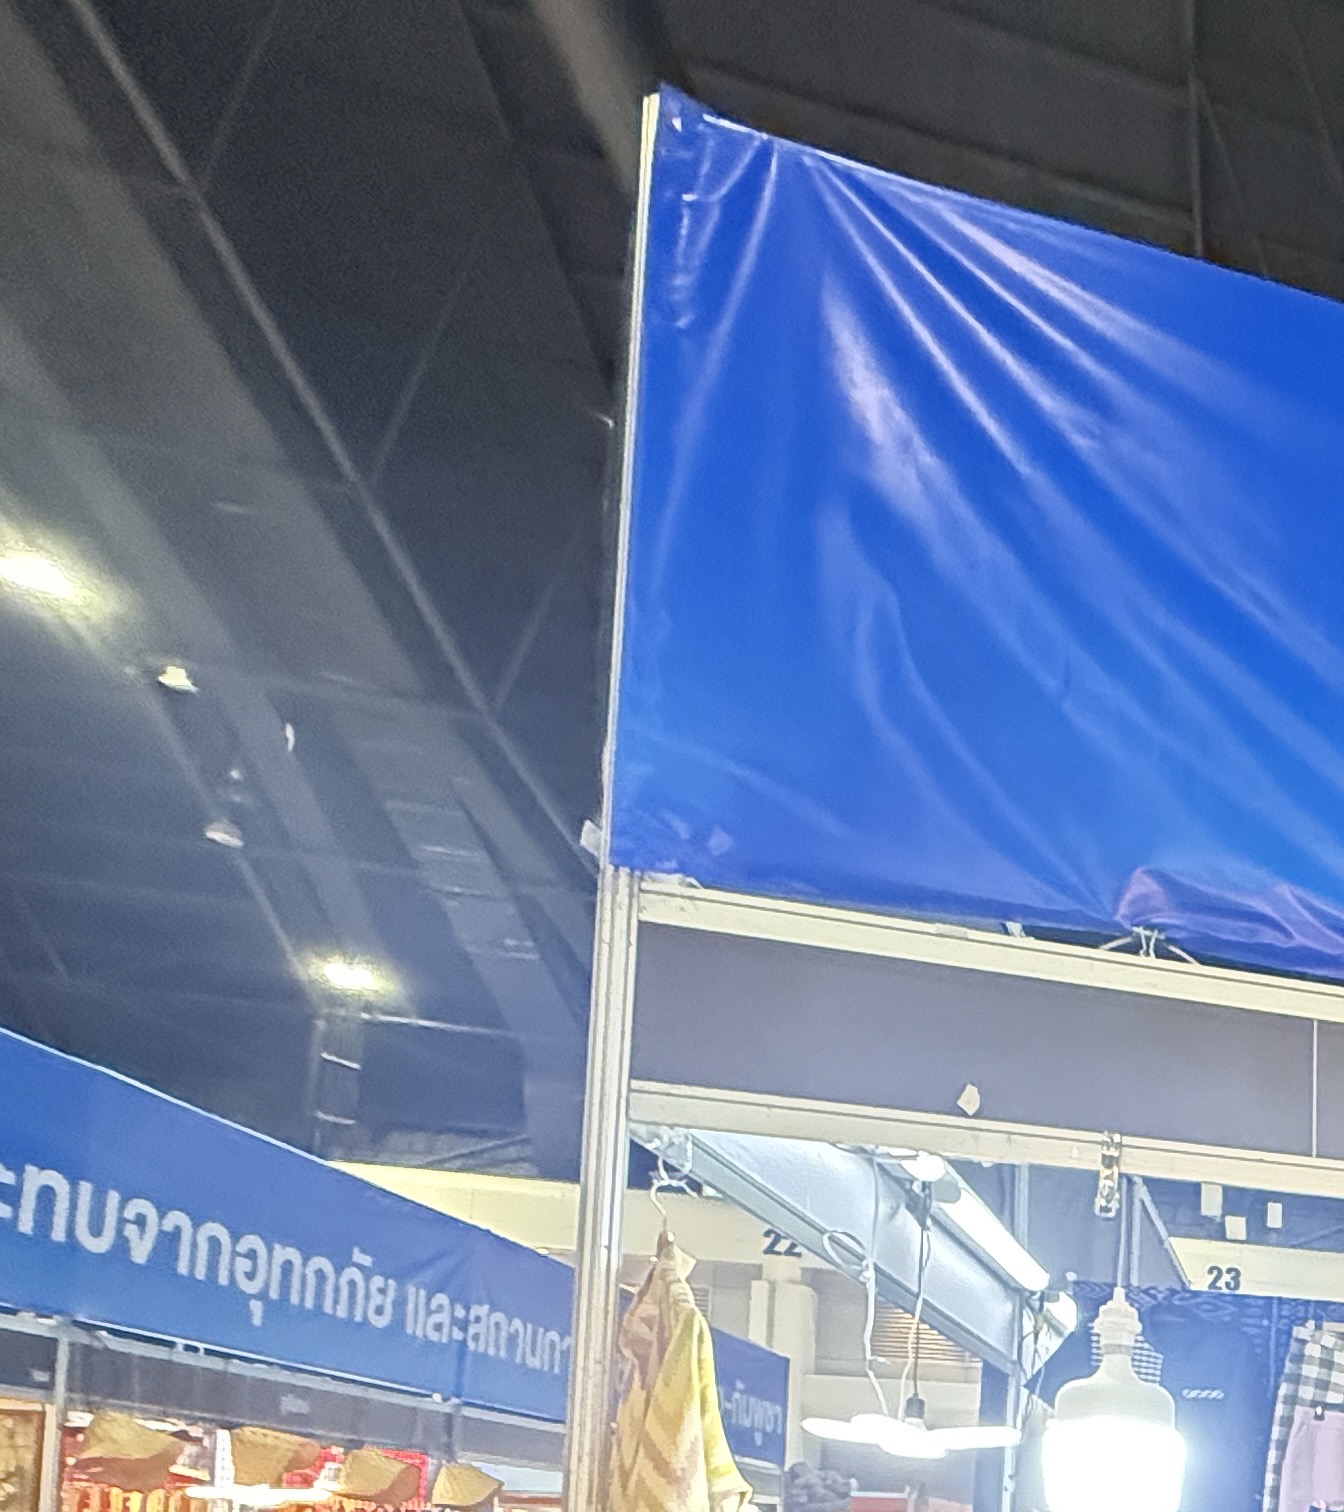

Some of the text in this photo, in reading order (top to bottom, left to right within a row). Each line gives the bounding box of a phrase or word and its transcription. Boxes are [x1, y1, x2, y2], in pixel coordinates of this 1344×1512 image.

[1207, 1265, 1241, 1292] 23
[718, 1378, 783, 1447] -กัมพูชา
